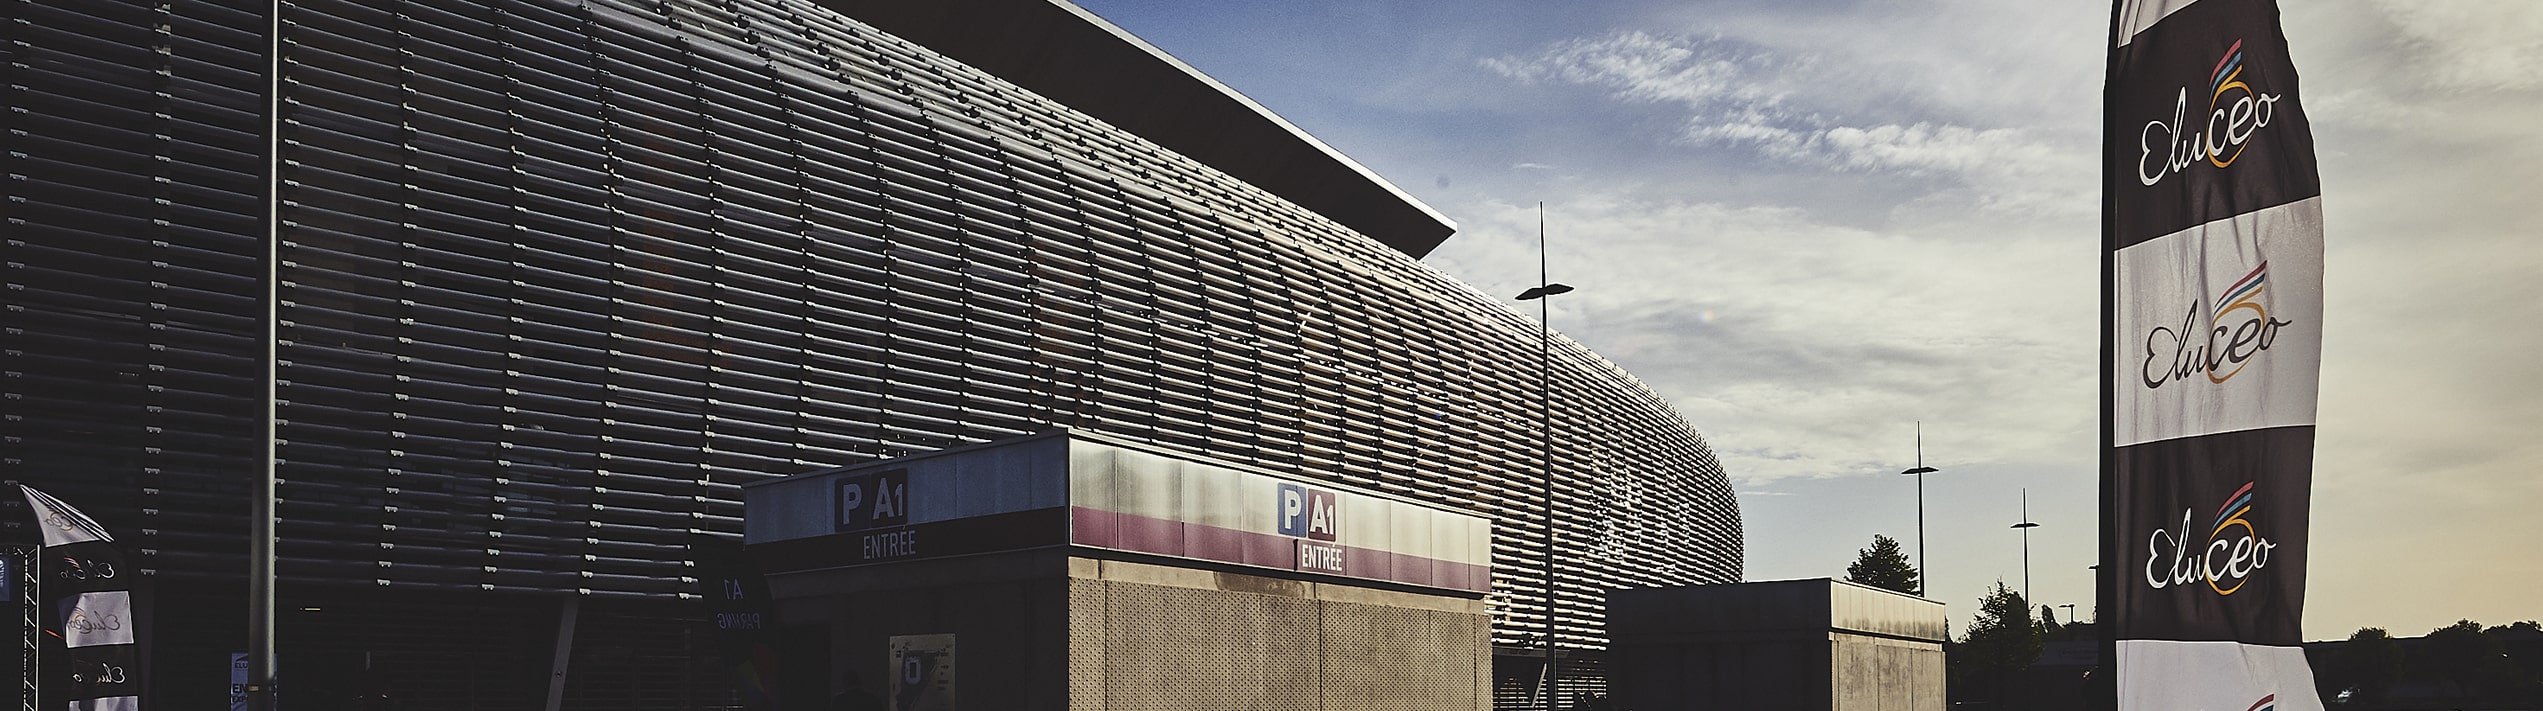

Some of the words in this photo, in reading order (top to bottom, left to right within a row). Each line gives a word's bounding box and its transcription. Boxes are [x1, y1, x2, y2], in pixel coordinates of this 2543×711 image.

[842, 483, 863, 525] P
[872, 477, 904, 520] A1
[1284, 489, 1302, 530] P
[1309, 494, 1335, 535] A1
[863, 525, 916, 560] ENTRÉE
[1303, 543, 1342, 571] ENTRÉE
